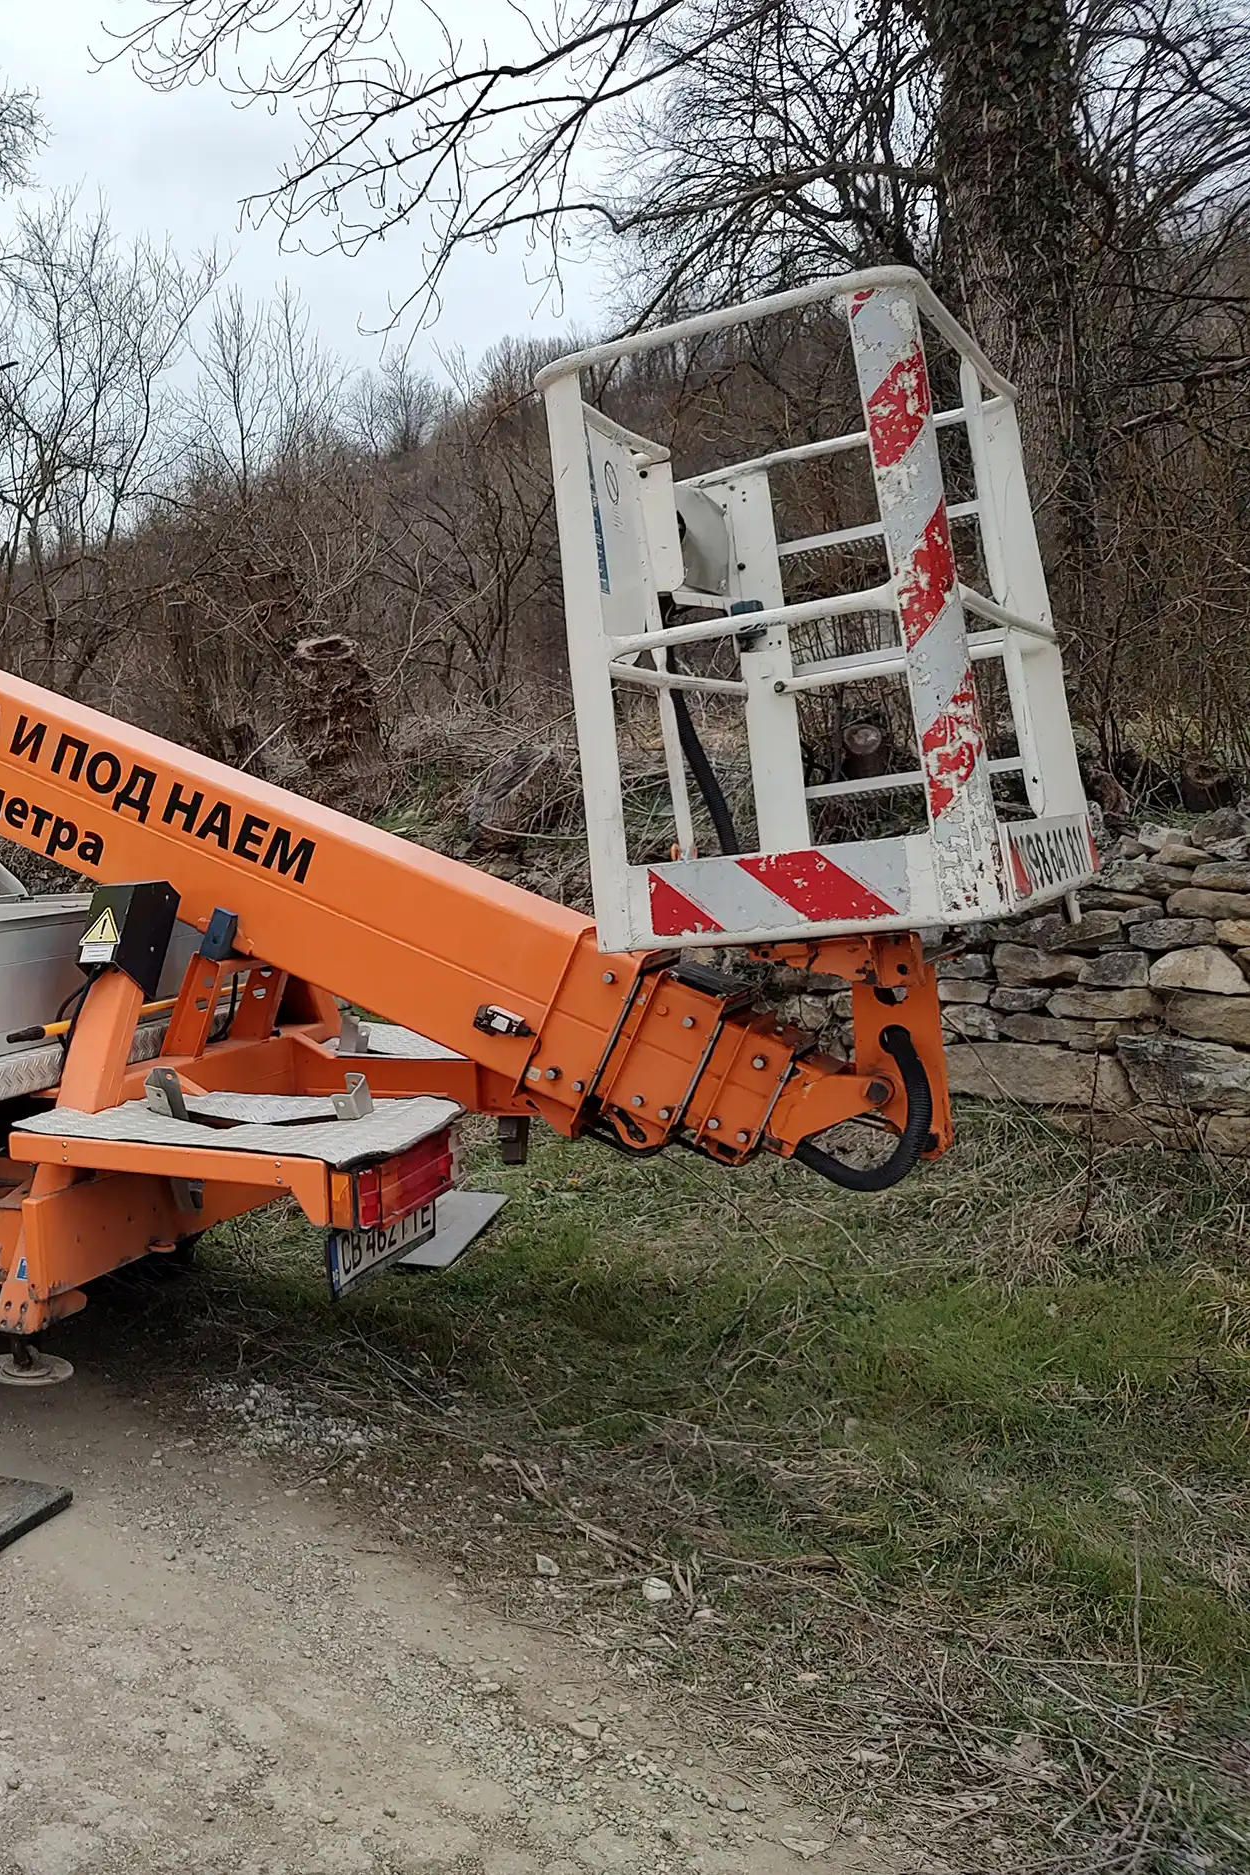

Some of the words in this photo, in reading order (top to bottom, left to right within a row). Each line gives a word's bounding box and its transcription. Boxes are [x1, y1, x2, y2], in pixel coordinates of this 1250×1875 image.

[9, 714, 48, 764] И
[51, 733, 158, 823] ПОД
[163, 783, 317, 885] НАЕМ
[1046, 829, 1074, 882] 641
[1066, 825, 1087, 875] 811
